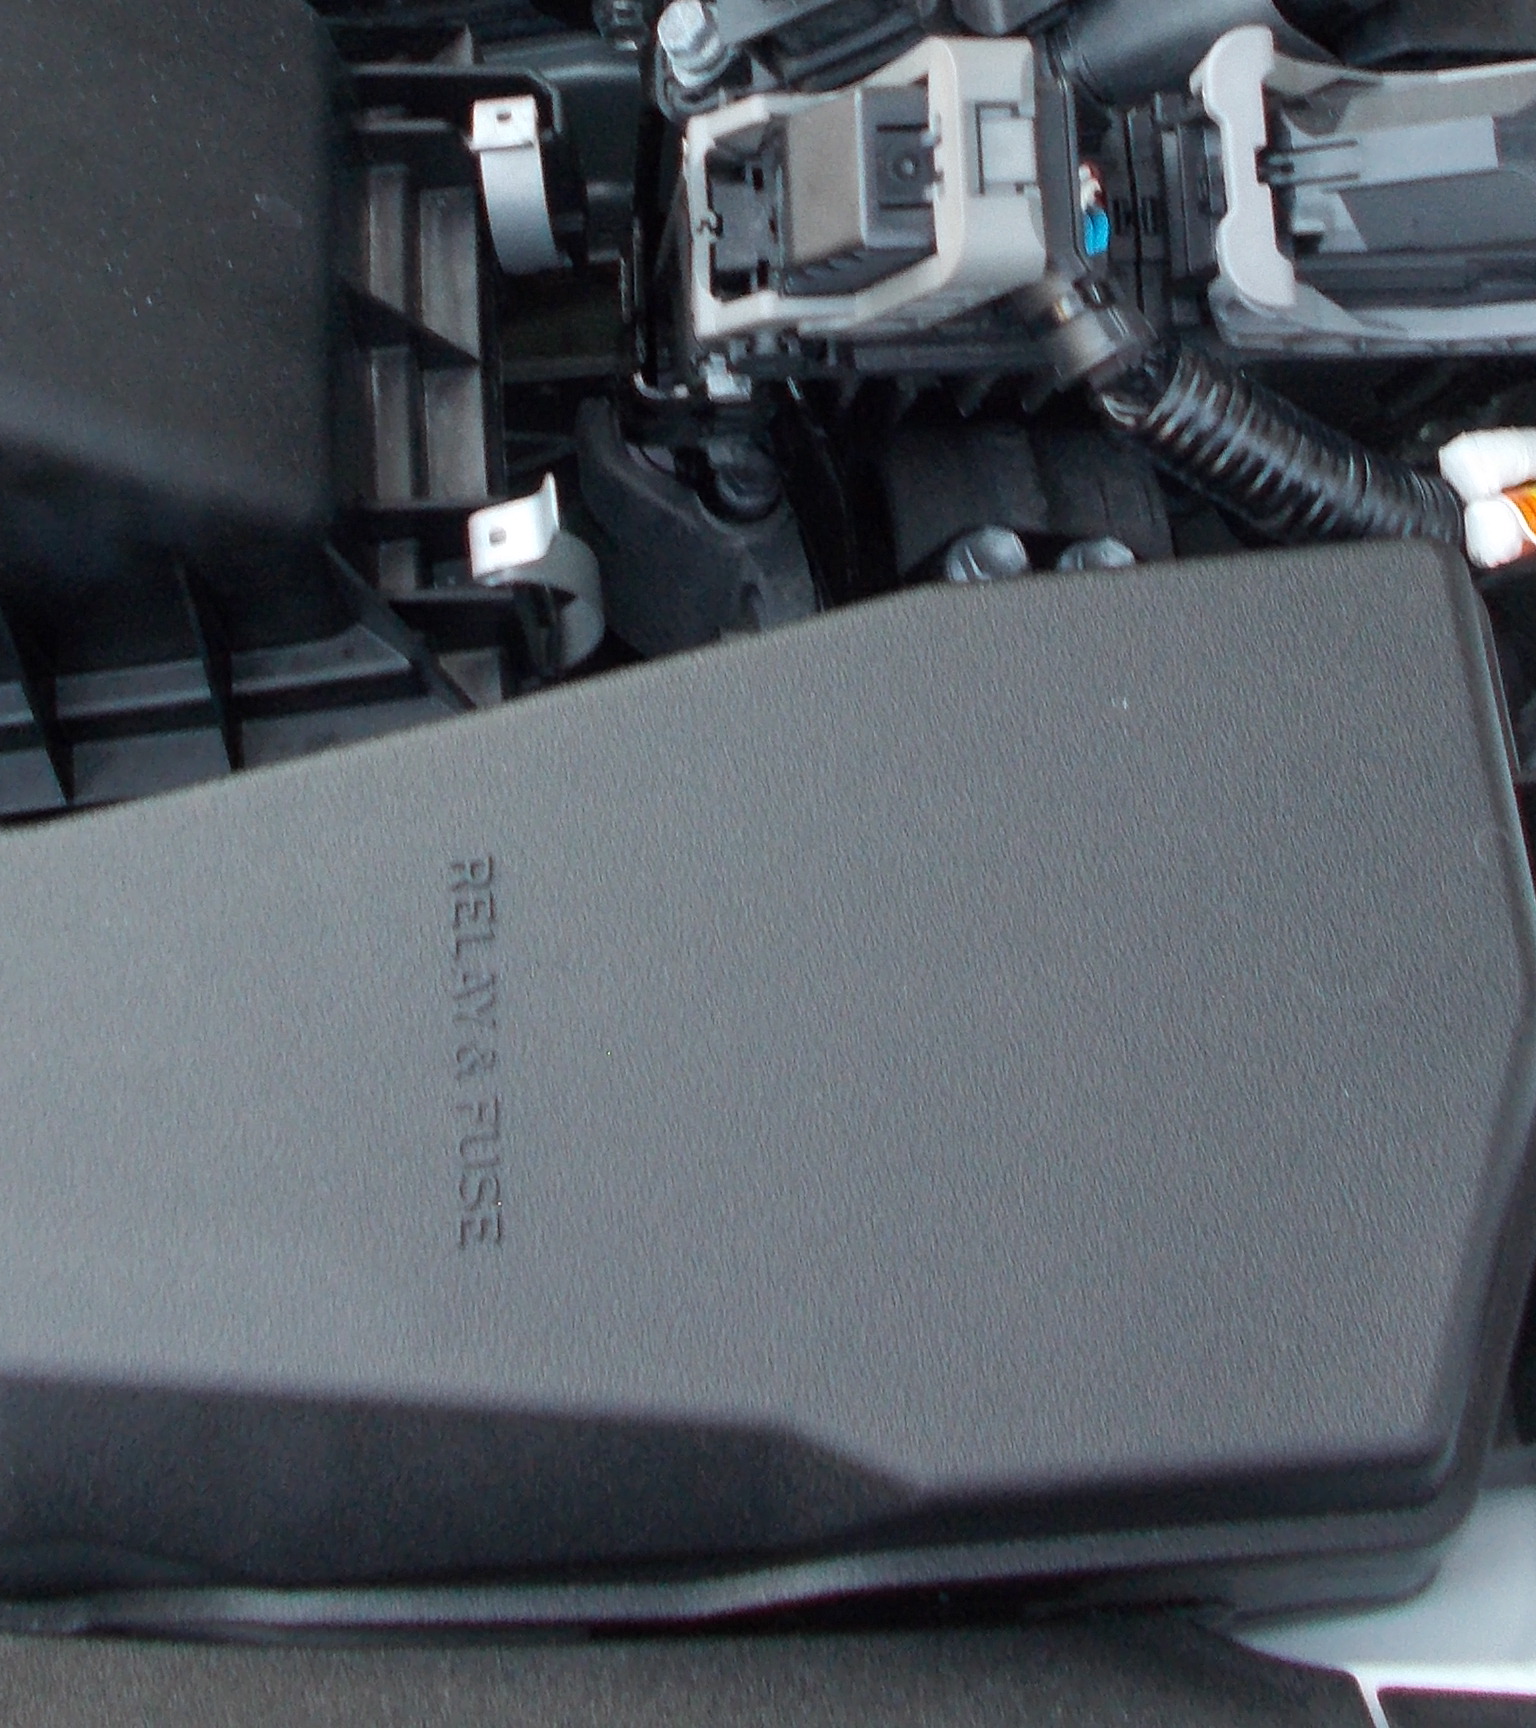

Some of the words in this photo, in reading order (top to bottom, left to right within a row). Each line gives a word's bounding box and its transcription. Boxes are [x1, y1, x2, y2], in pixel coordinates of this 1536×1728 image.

[449, 855, 497, 1030] RELAY
[455, 1046, 498, 1079] &
[455, 1094, 505, 1249] FUSE
